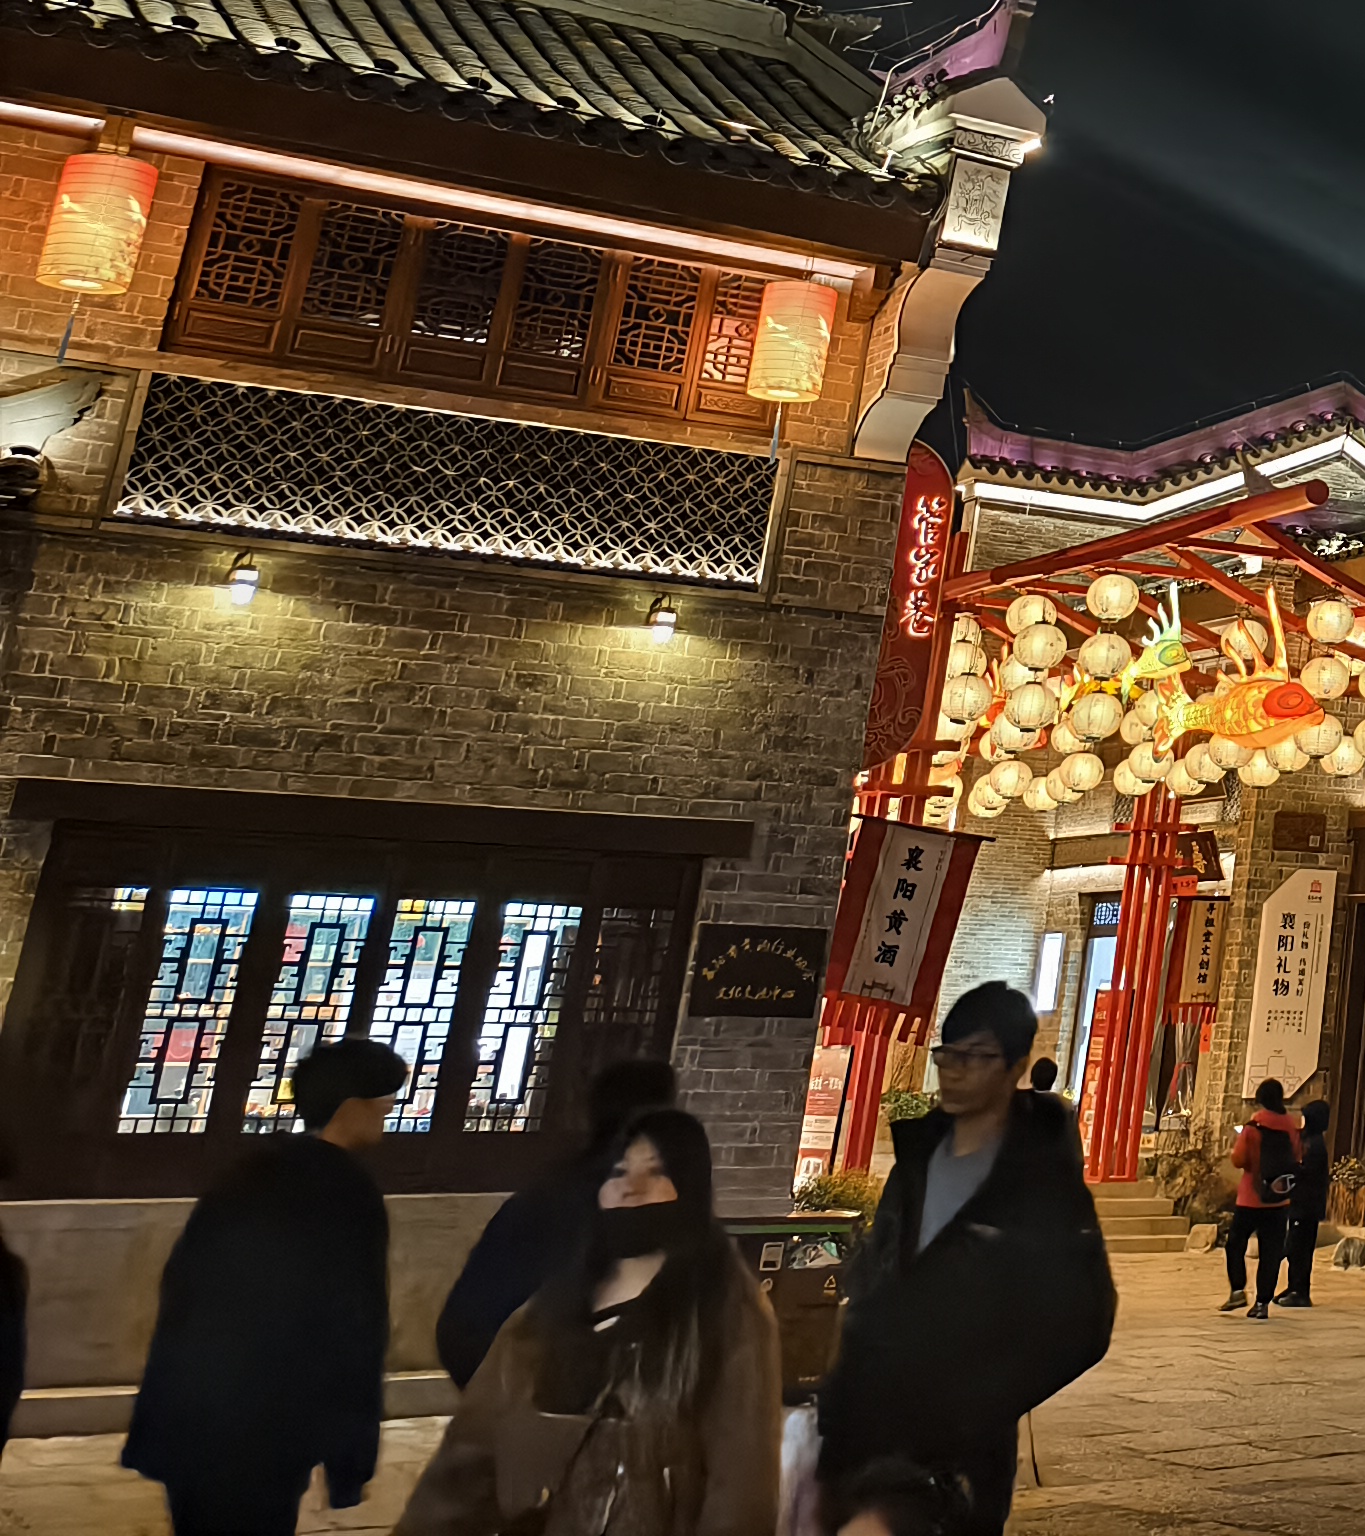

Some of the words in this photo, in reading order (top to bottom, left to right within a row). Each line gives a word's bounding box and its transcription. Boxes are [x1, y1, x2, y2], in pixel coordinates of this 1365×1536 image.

[900, 495, 946, 637] 管家巷
[874, 845, 925, 967] 襄阳黄酒
[1272, 912, 1297, 996] 襄阳礼物
